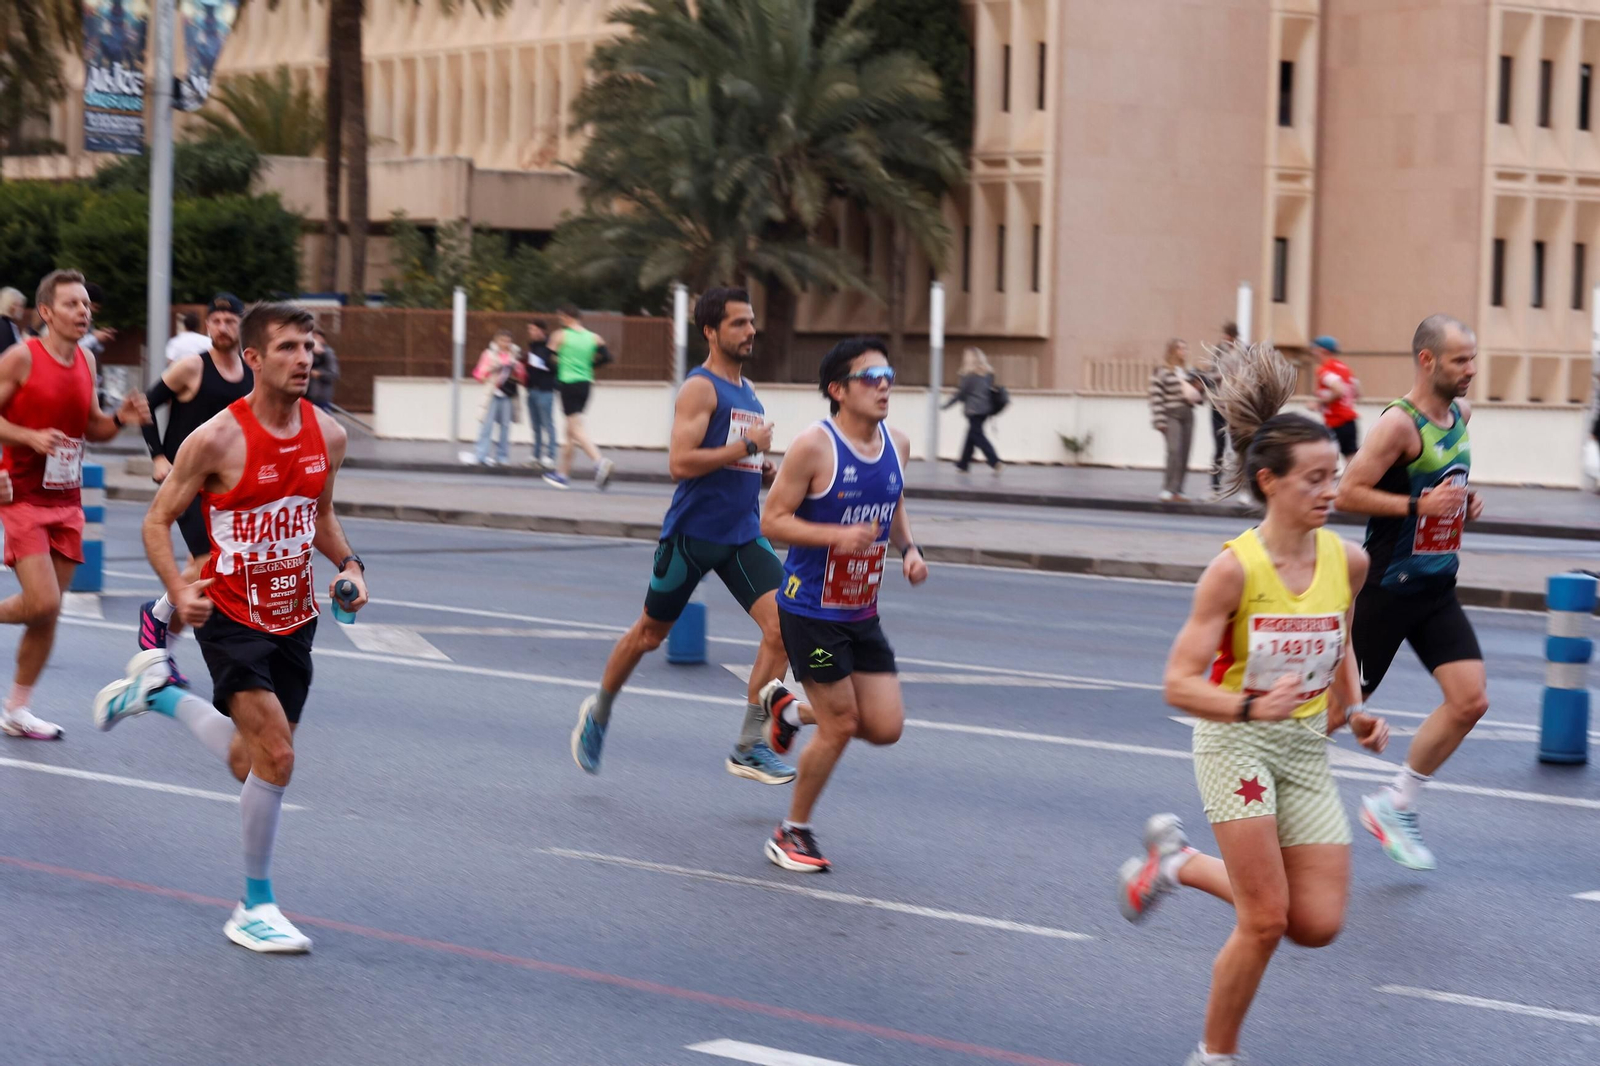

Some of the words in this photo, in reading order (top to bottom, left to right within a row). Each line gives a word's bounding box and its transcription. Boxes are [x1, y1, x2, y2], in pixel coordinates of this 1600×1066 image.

[232, 500, 318, 543] MARAT
[841, 502, 897, 525] ASPORT
[270, 575, 297, 590] 350
[1270, 639, 1325, 656] 14919
